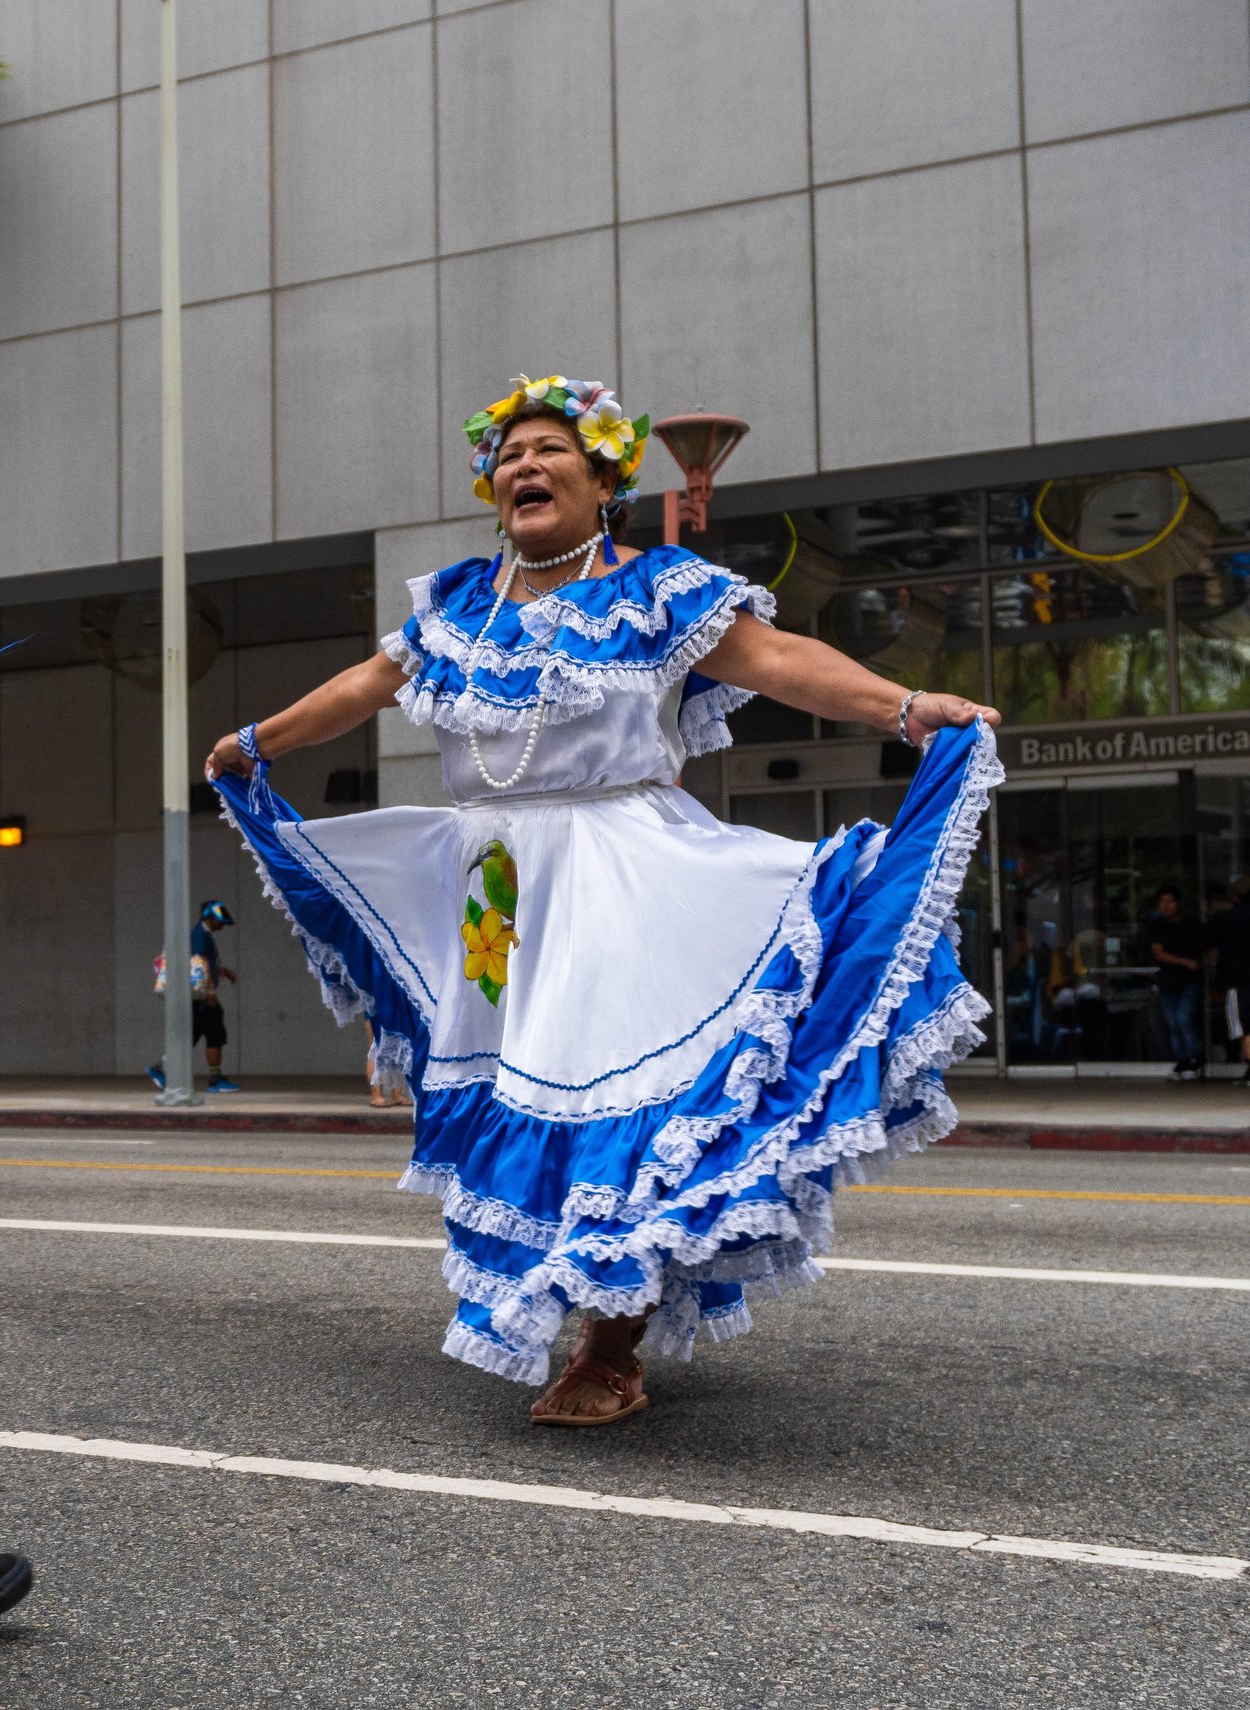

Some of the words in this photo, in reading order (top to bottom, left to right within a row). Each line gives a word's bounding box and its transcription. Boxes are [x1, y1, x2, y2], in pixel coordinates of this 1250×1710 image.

[1021, 735, 1093, 765] Bank
[1096, 732, 1126, 760] of
[1130, 725, 1250, 758] America
